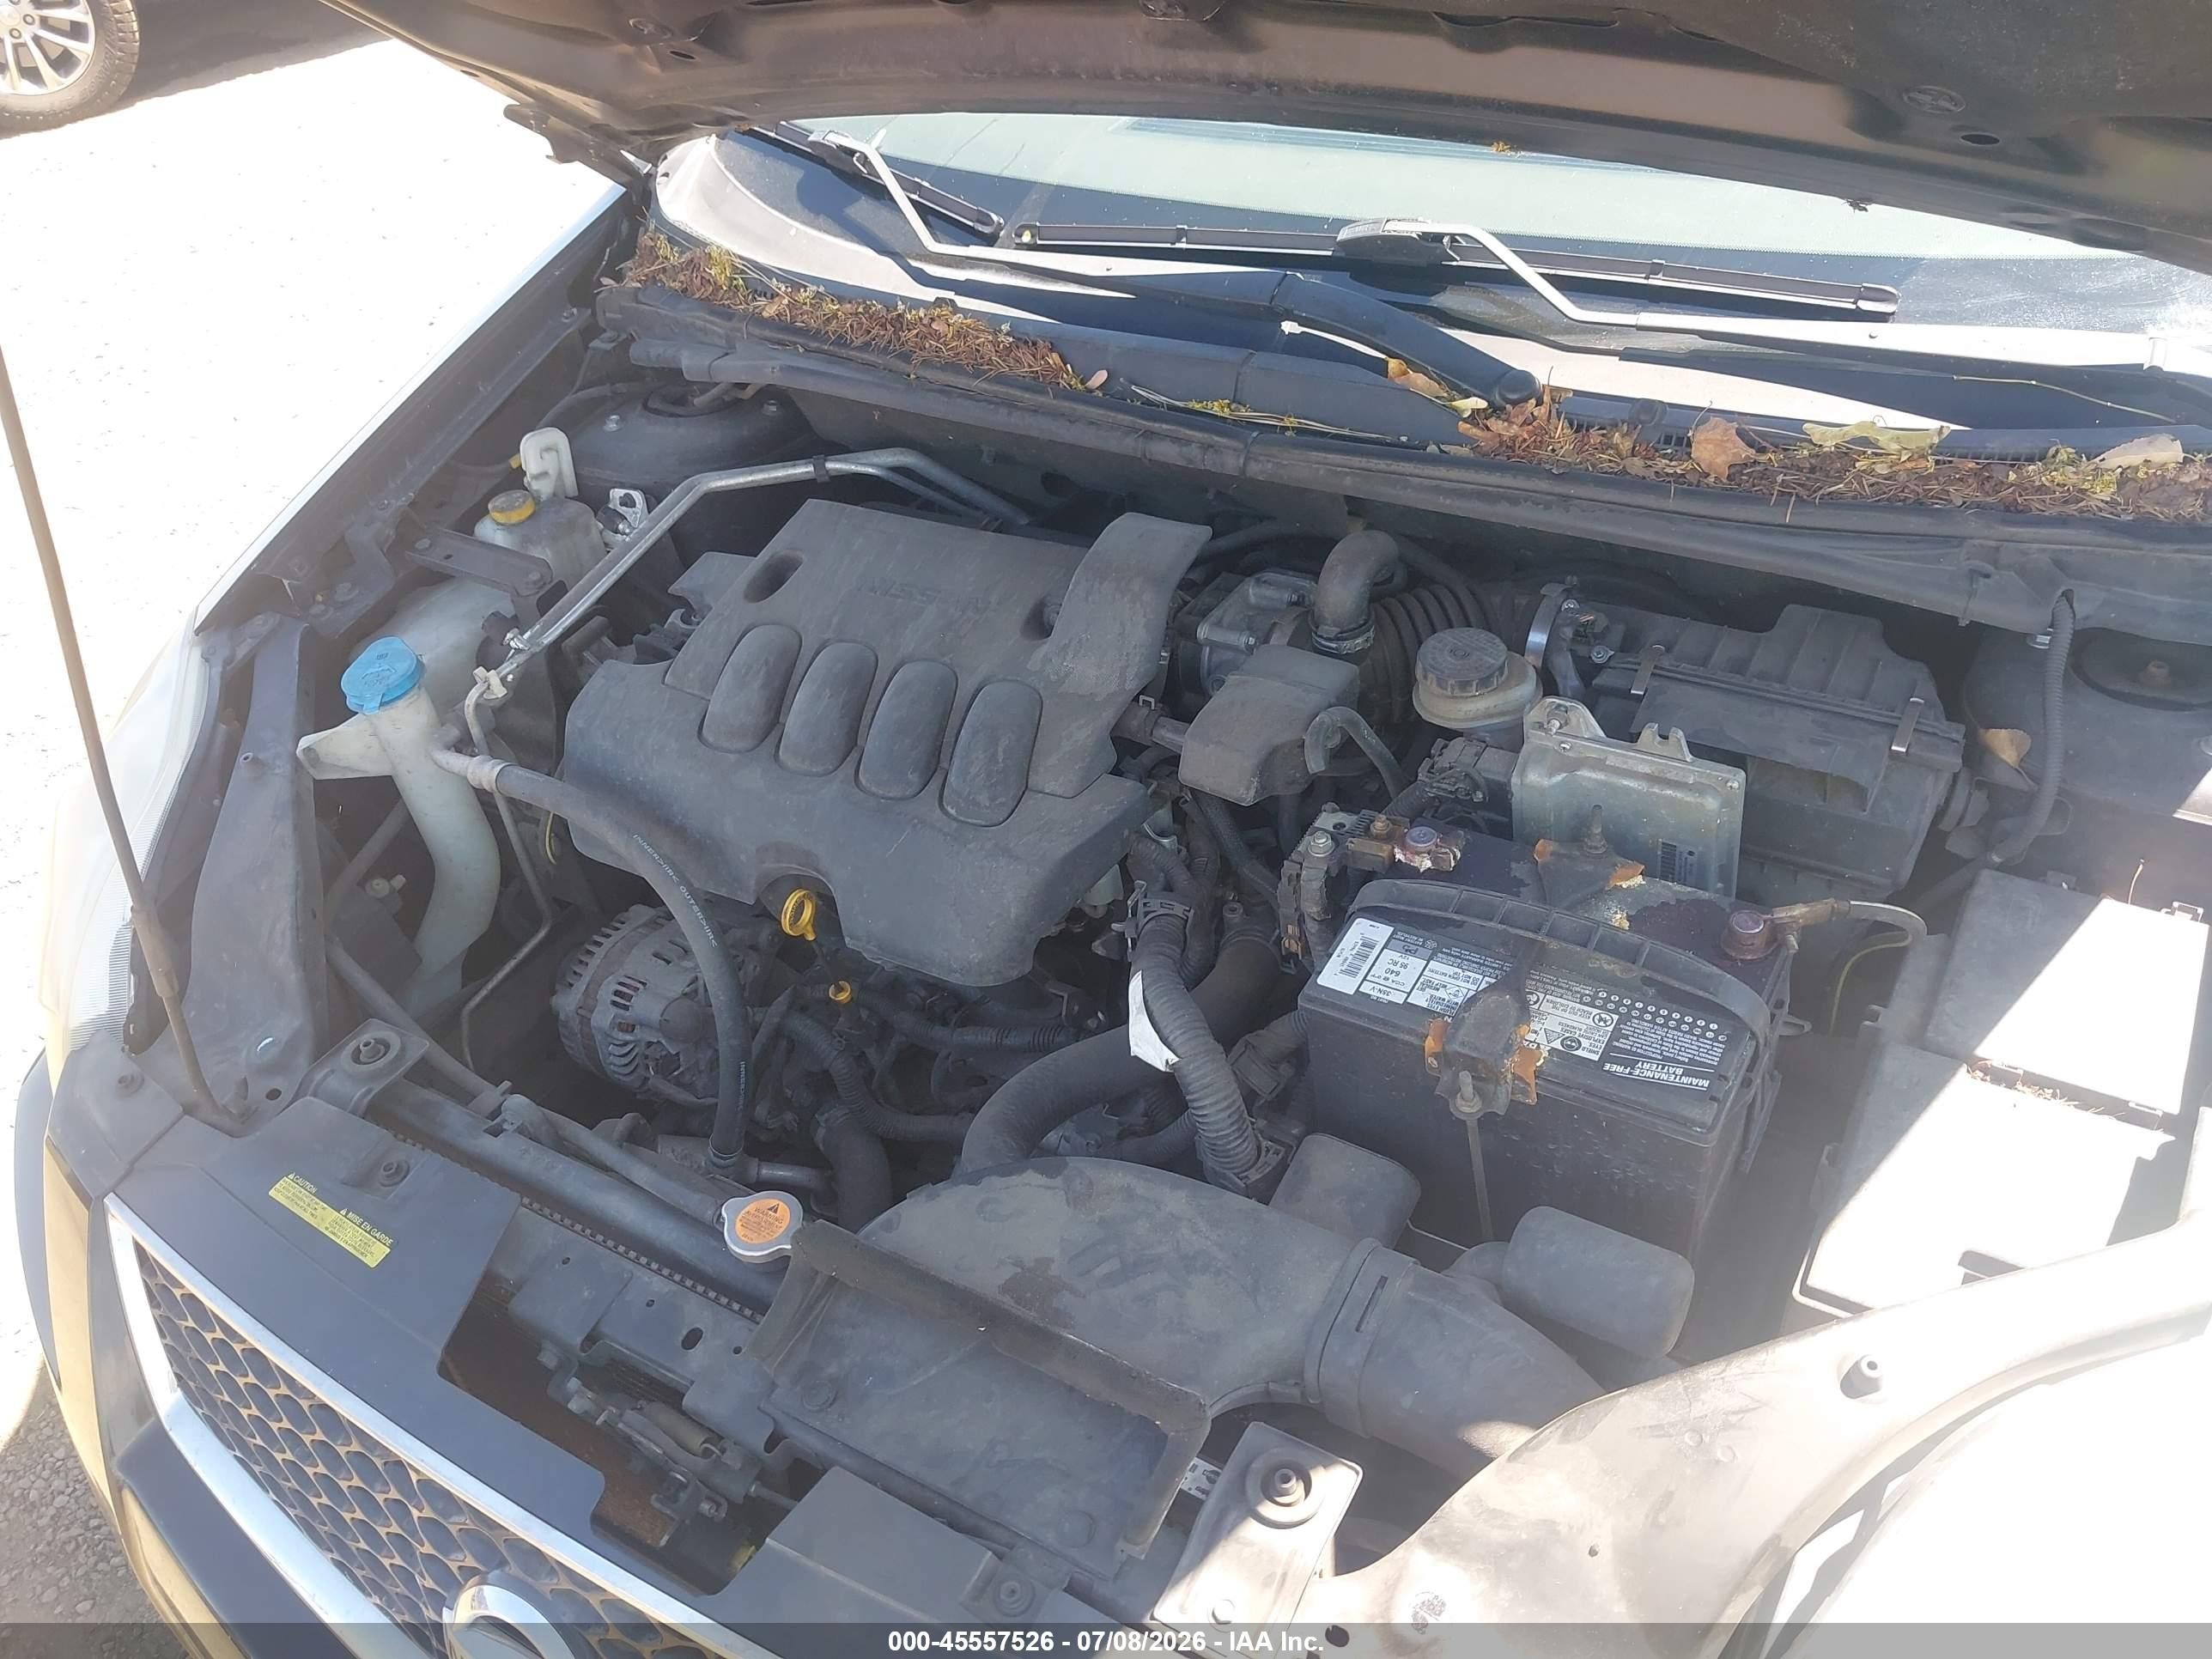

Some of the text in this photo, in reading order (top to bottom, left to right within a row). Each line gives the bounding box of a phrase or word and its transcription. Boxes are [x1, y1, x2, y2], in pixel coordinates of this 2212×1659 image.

[1400, 944, 1419, 955] Pb
[1386, 958, 1400, 967] RC
[1383, 967, 1401, 977] 640
[1577, 1032, 1605, 1045] EXPLOSIVE
[1602, 1062, 1711, 1086] MAINTENANCE-FREE
[1634, 1060, 1684, 1075] BATTERY
[293, 1176, 318, 1194] CAUTION
[754, 1206, 783, 1224] WARNING
[347, 1212, 393, 1246] MISE EN GARDE
